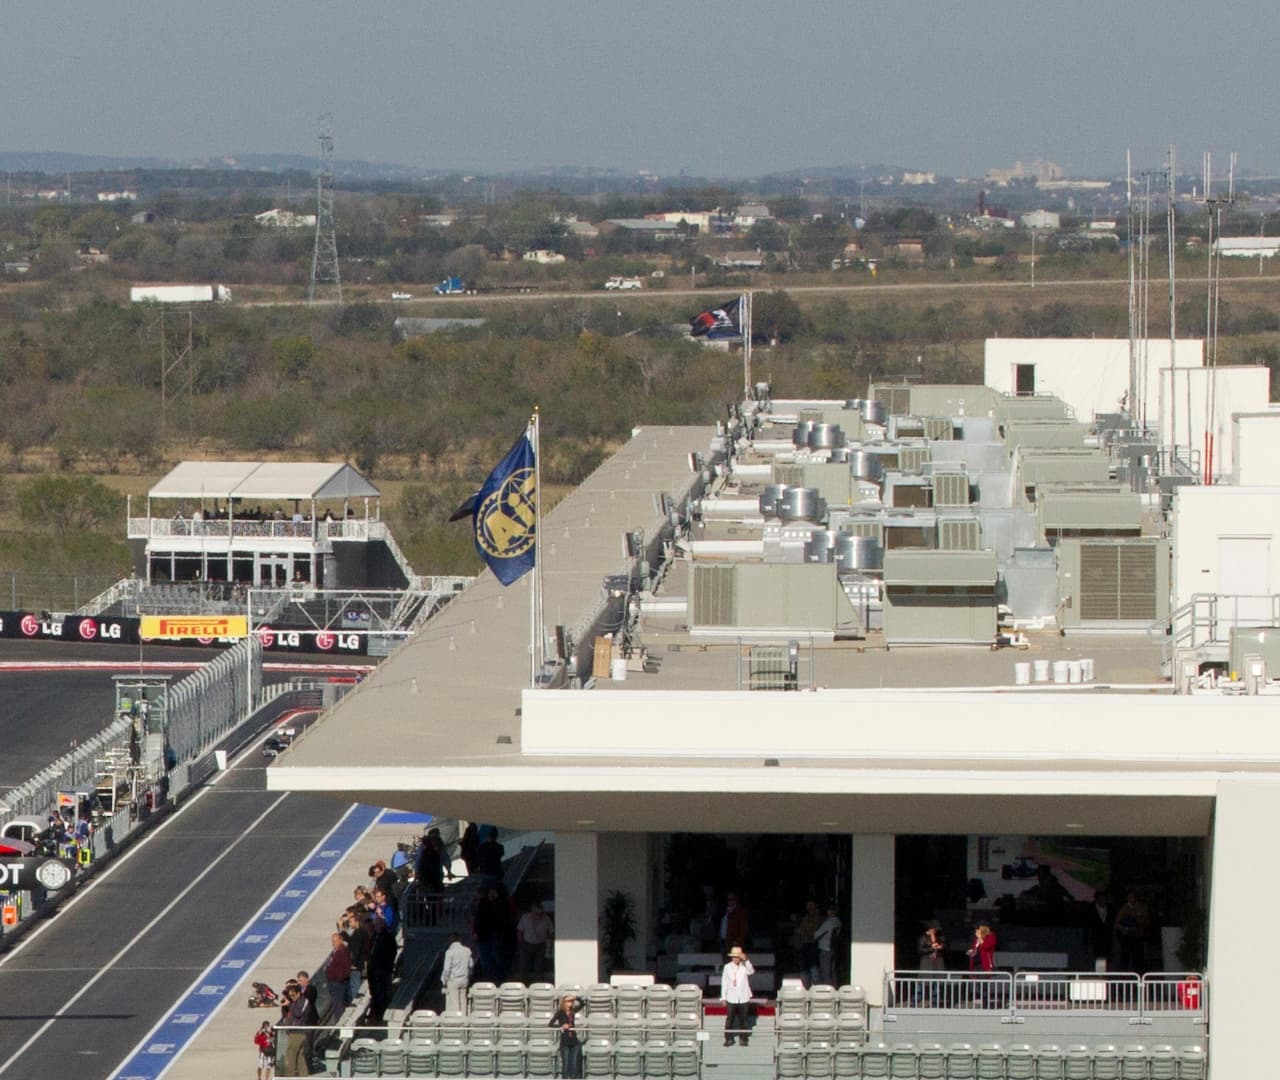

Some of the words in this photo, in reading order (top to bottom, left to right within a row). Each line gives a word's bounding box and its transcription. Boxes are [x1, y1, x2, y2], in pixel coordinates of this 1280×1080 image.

[42, 622, 63, 636] LG
[100, 623, 121, 638] LG
[160, 619, 228, 636] PIRELLI
[277, 634, 300, 647] LG
[337, 637, 359, 649] LG
